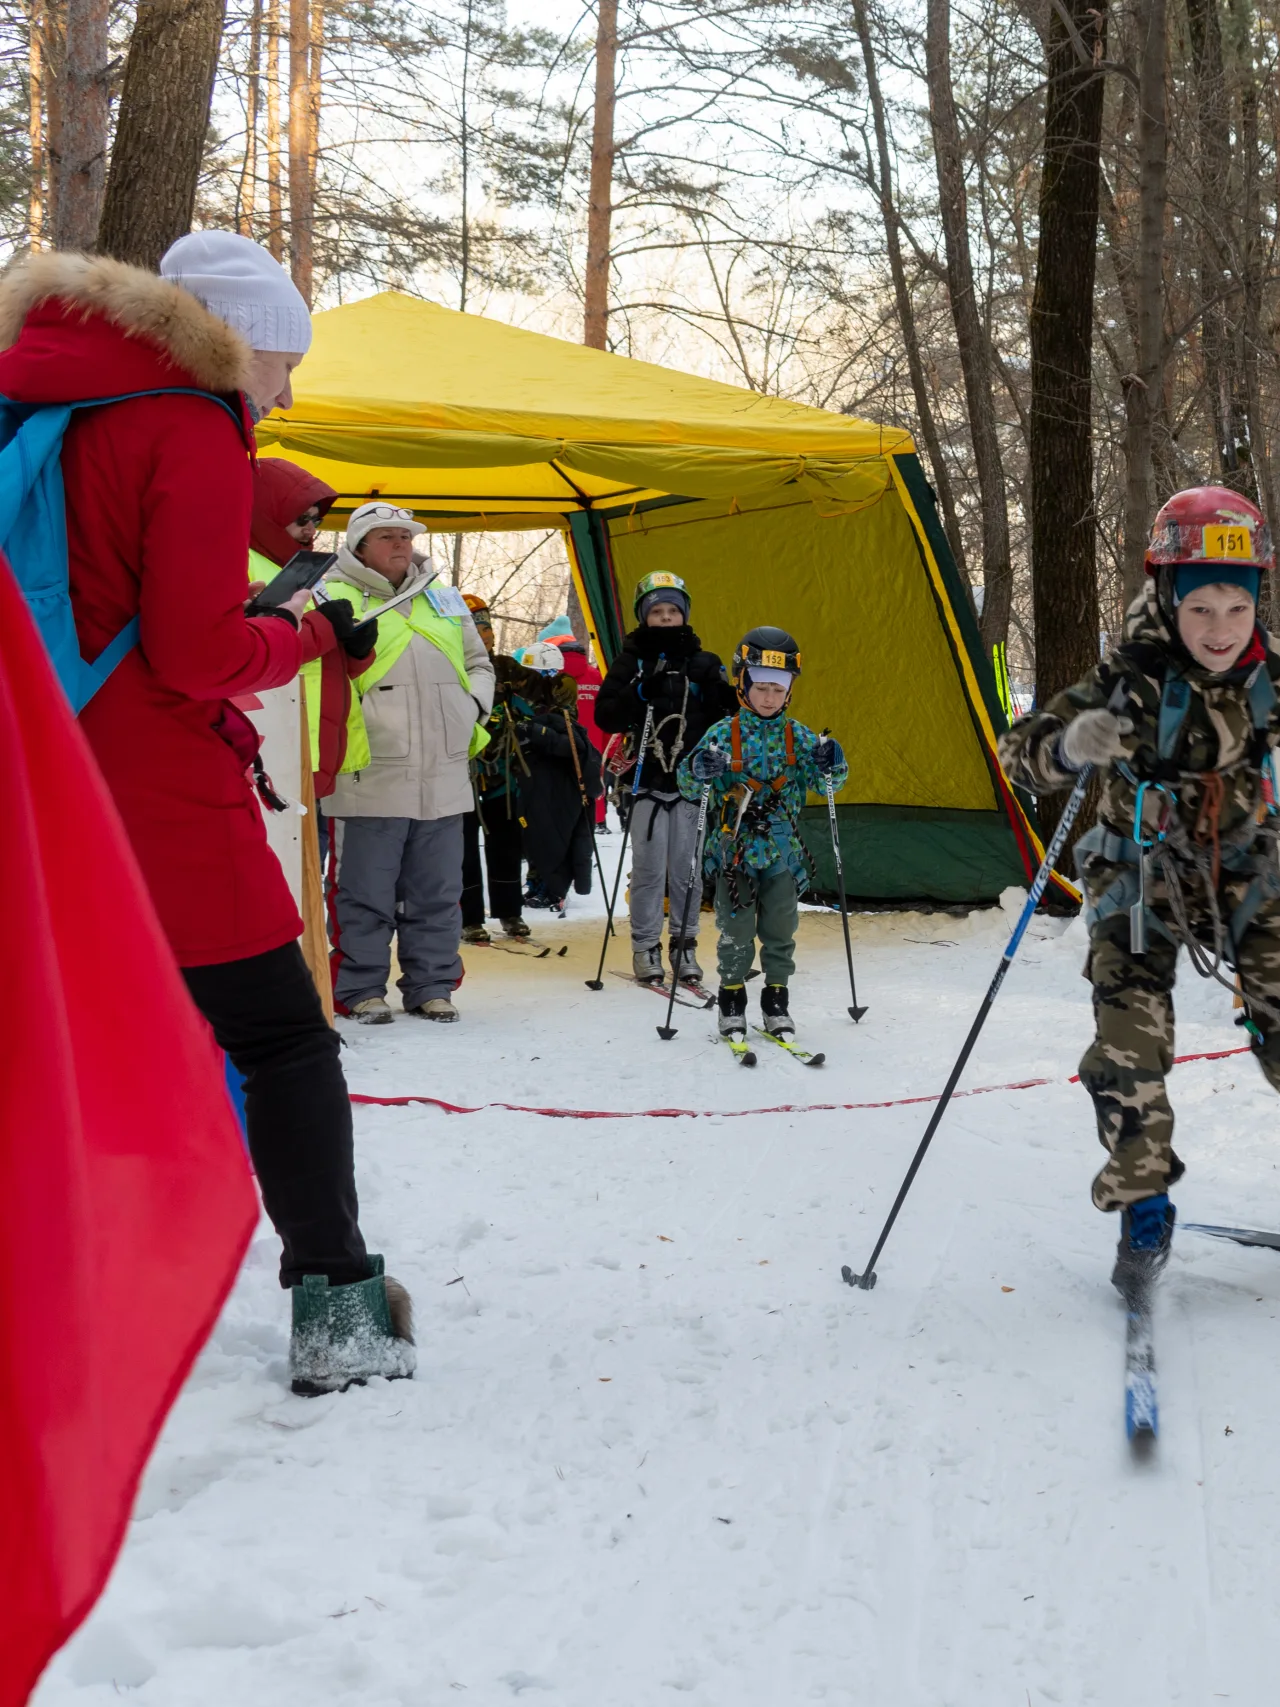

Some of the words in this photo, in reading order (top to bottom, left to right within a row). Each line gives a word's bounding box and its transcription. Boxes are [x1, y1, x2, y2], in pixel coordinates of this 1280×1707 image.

[1217, 533, 1243, 551] 151
[766, 654, 782, 665] 152
[698, 797, 708, 828] NORDWAY
[828, 787, 836, 817] NORDWAY
